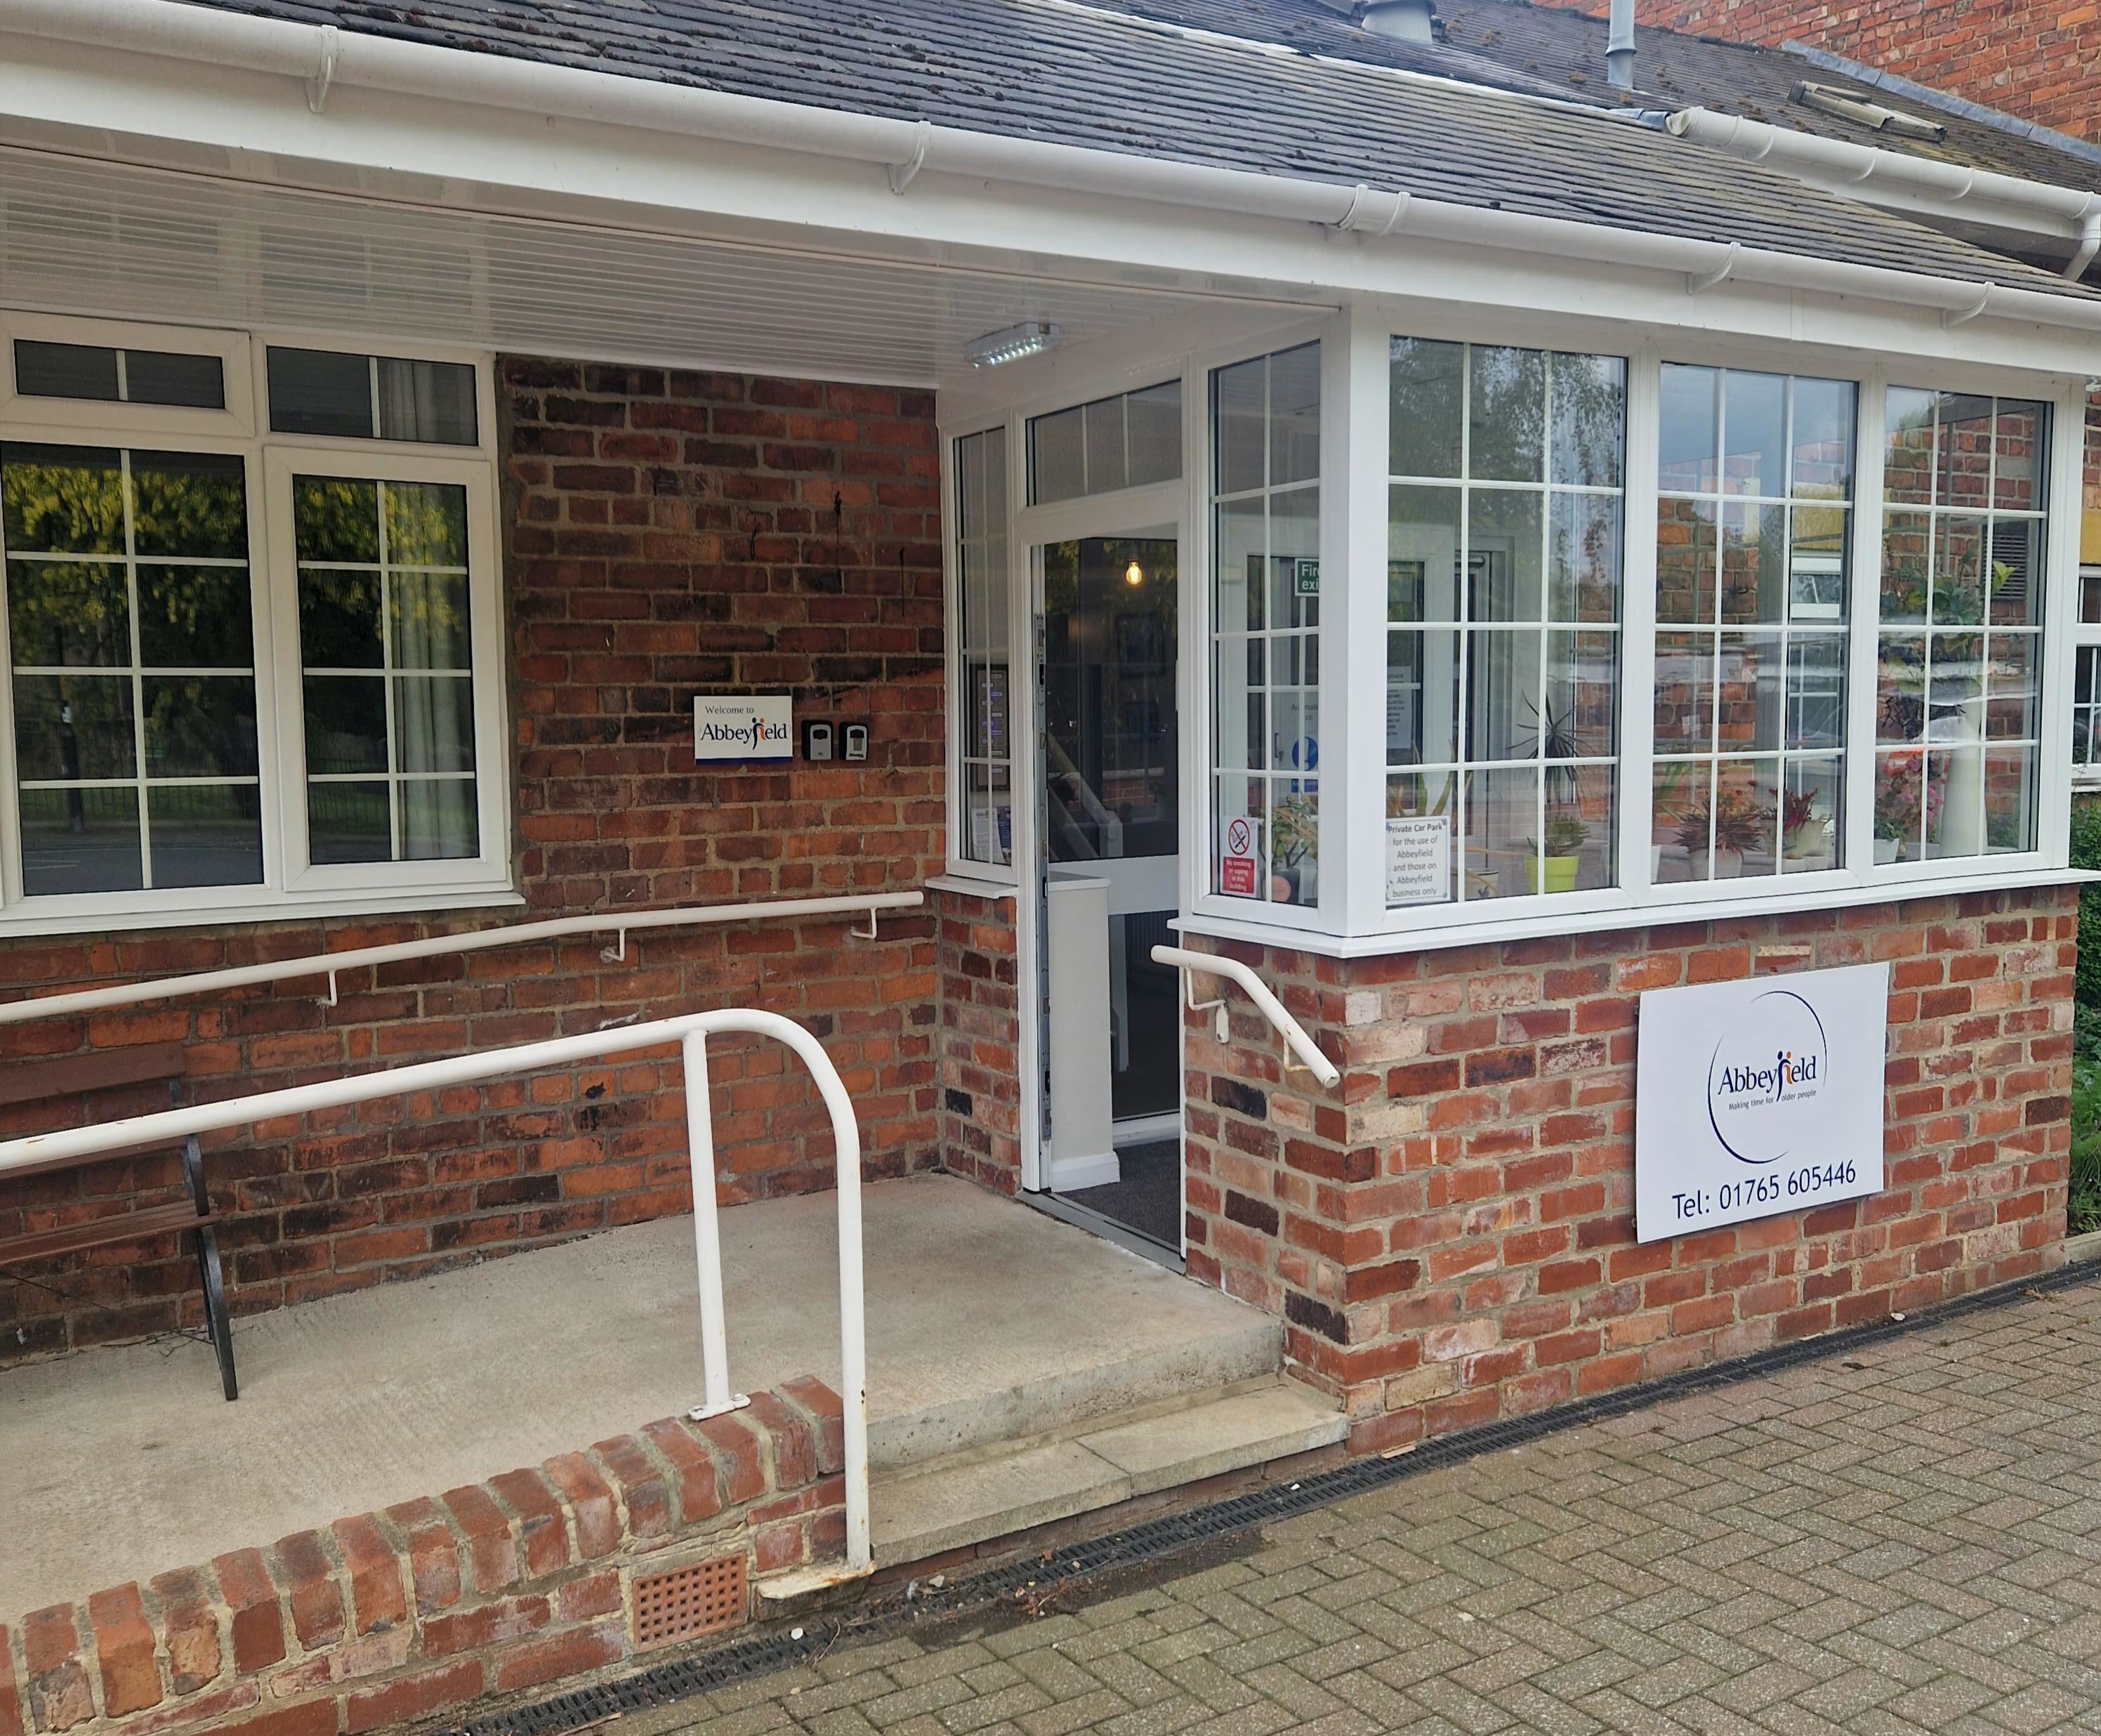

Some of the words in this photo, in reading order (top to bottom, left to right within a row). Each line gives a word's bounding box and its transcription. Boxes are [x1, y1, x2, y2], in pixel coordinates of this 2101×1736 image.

[1302, 578, 1319, 590] exi
[705, 706, 744, 714] Welcome
[700, 717, 788, 750] Abbeyfield
[1427, 822, 1442, 831] Park
[1430, 835, 1438, 843] of
[1397, 848, 1433, 859] Abbeyfield
[1397, 874, 1432, 884] Abbeyfield
[1392, 888, 1421, 897] business
[1422, 887, 1437, 895] only
[1717, 1051, 1817, 1102] Abbeyfield
[1729, 1101, 1749, 1110] Making
[1751, 1098, 1764, 1107] time
[1781, 1092, 1796, 1101] older
[1798, 1089, 1817, 1100] people
[1672, 1189, 1711, 1219] Tel:
[1719, 1174, 1779, 1210] 01765
[1787, 1159, 1857, 1195] 605446
